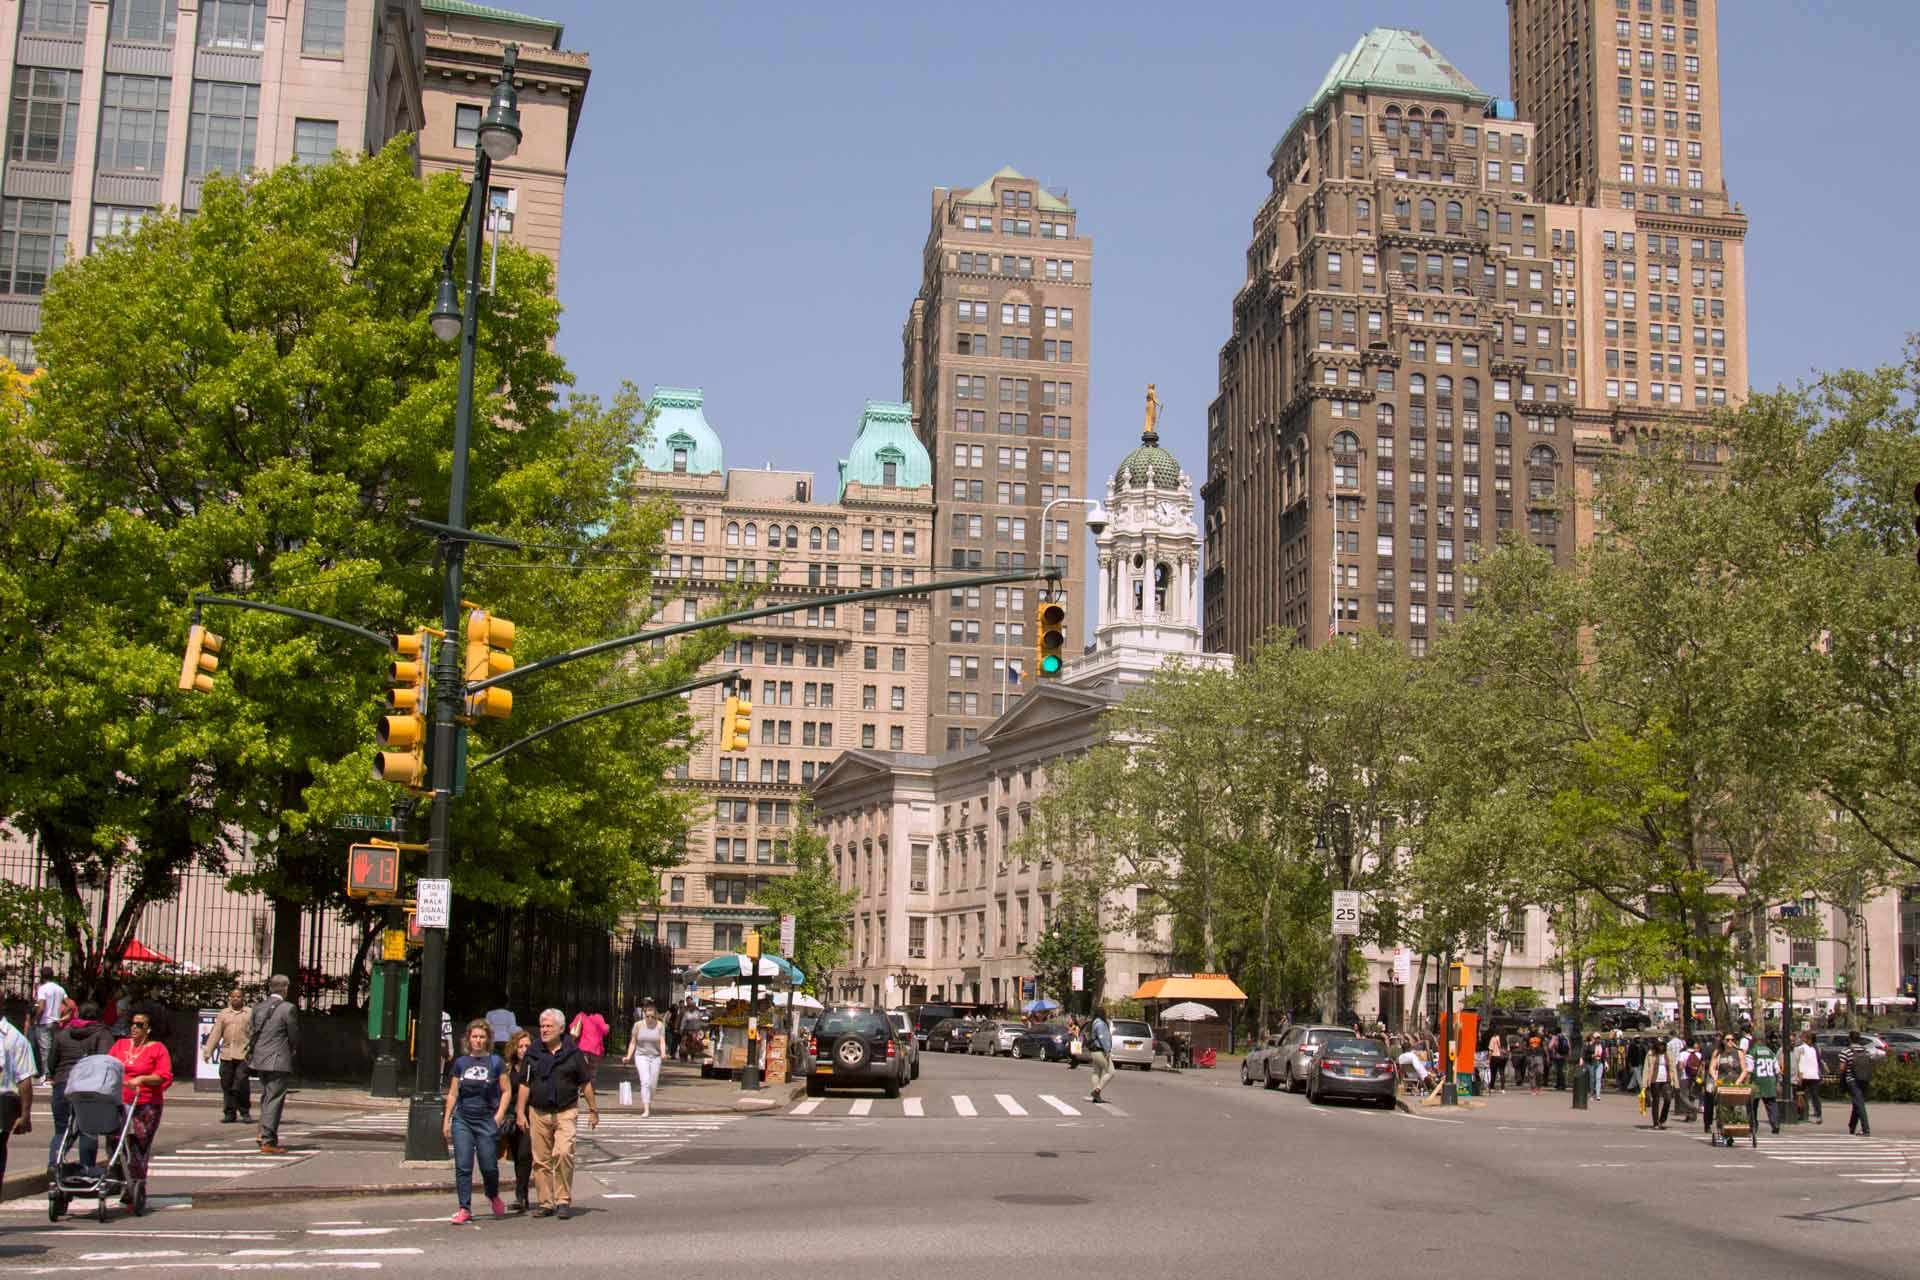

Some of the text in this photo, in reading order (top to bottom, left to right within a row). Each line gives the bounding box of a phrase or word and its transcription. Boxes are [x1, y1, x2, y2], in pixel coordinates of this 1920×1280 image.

[379, 857, 394, 883] 13
[1336, 908, 1356, 920] 25
[1757, 1058, 1775, 1077] 20
